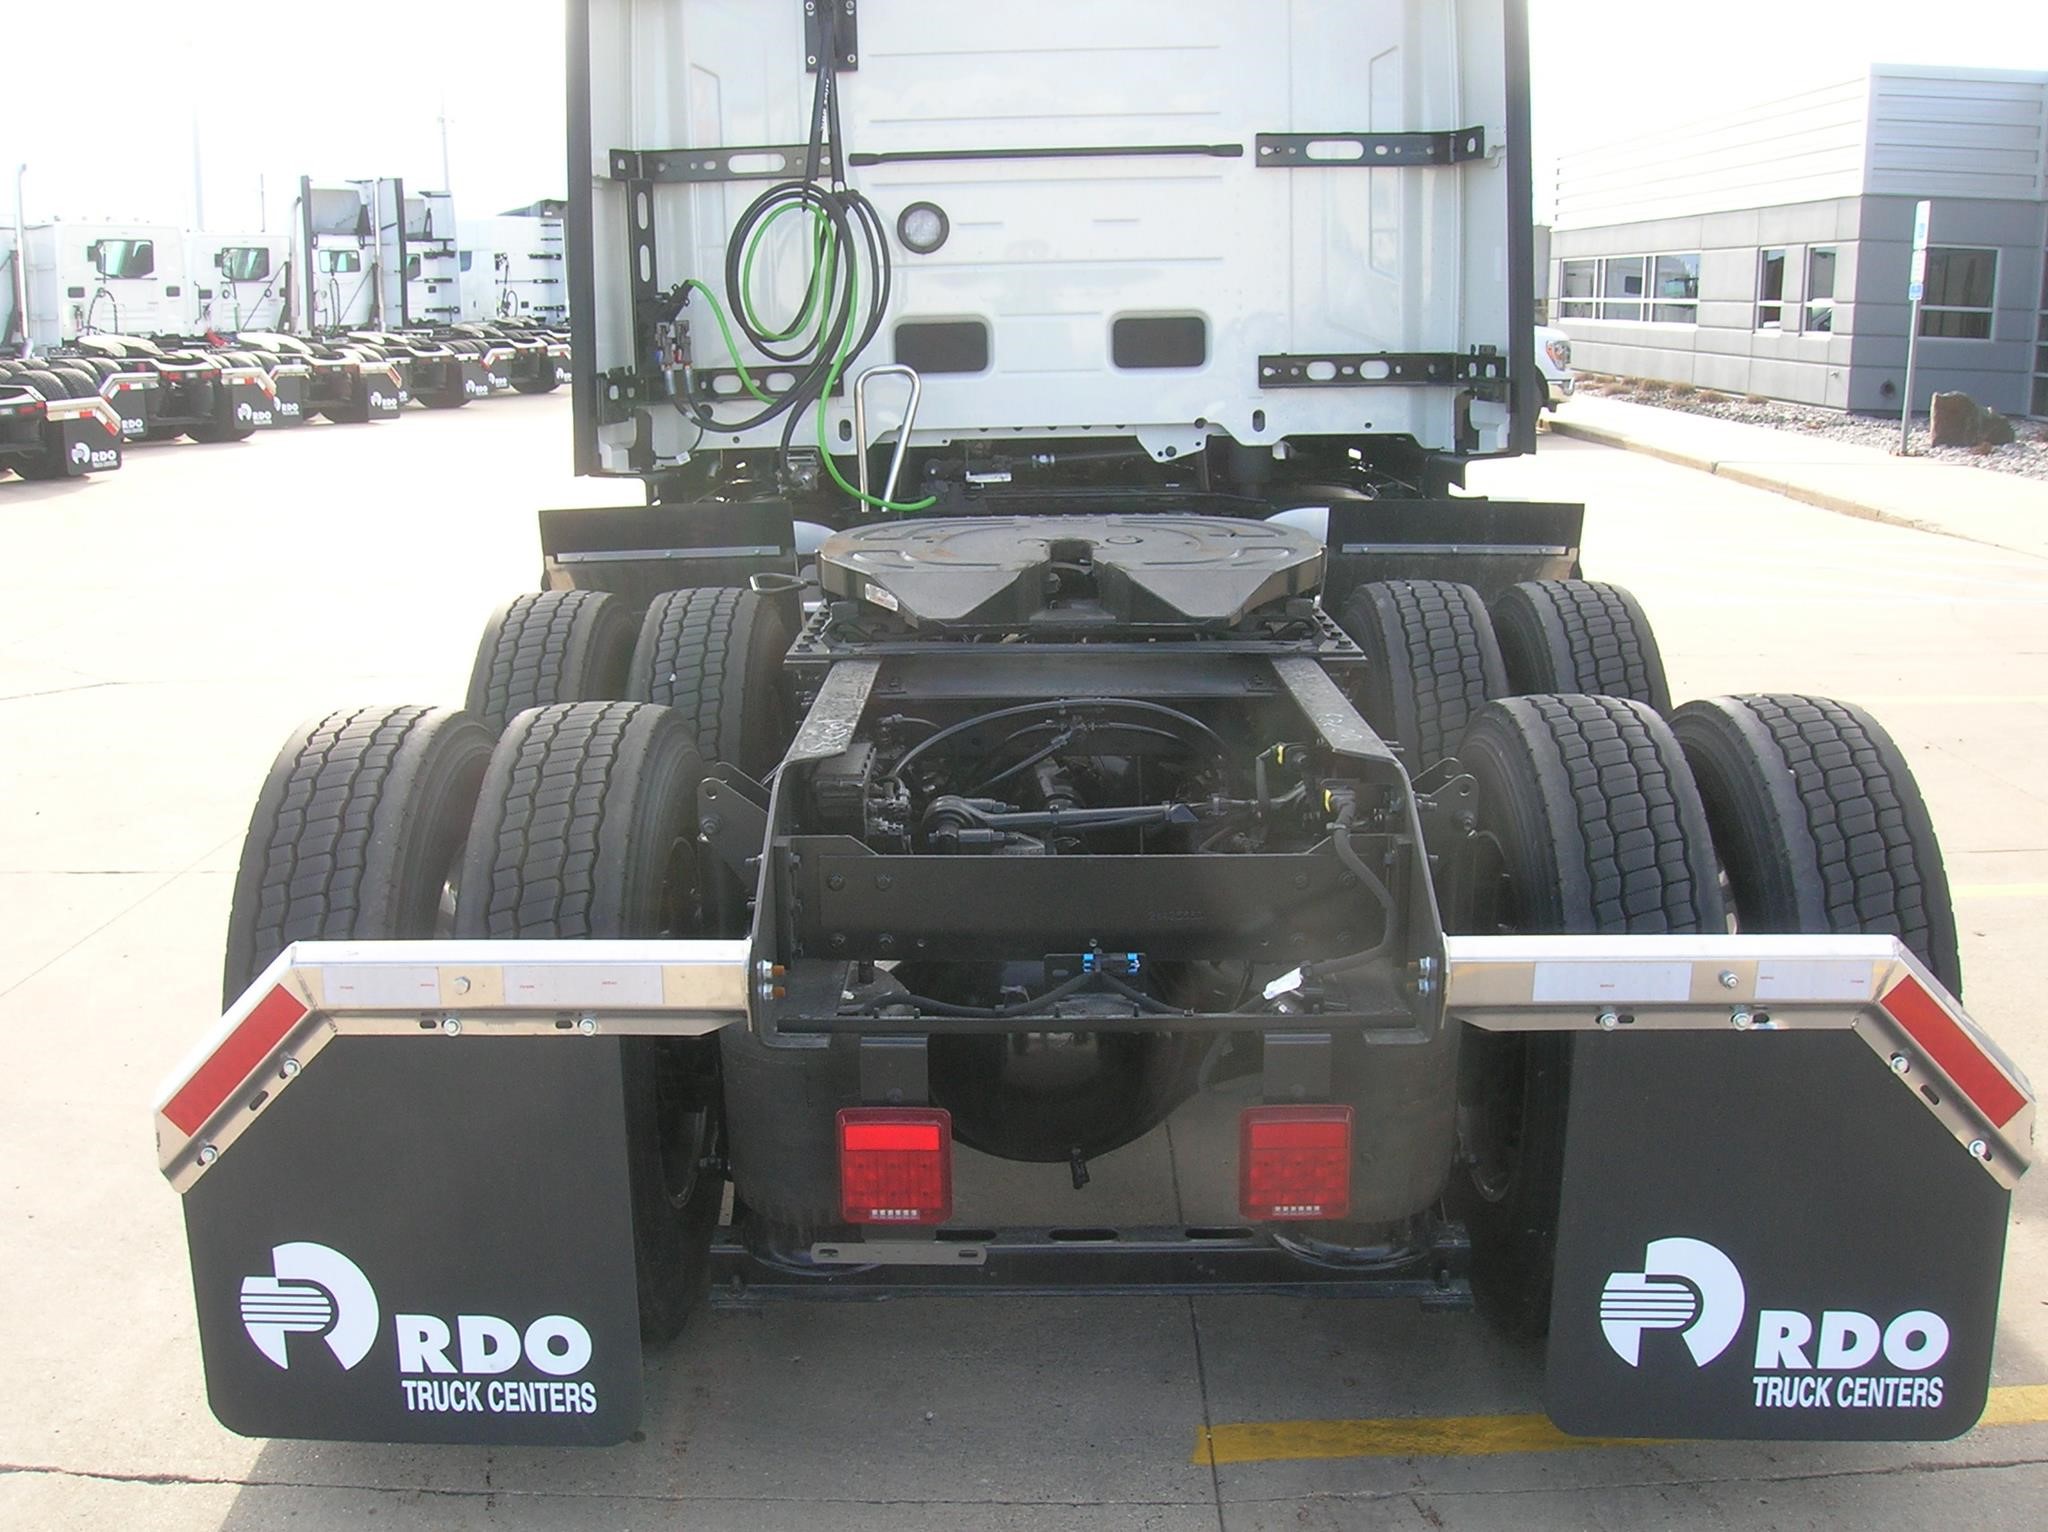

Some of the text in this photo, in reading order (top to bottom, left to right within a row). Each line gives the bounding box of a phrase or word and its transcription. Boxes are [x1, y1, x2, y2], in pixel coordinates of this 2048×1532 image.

[252, 411, 272, 420] RDO
[281, 403, 299, 411] RDO
[121, 419, 144, 428] RDO
[91, 450, 117, 462] RDO
[395, 1314, 592, 1375] RDO
[1754, 1310, 1949, 1371] RDO
[401, 1380, 597, 1414] TRUCK CENTERS
[1752, 1376, 1944, 1408] TRUCK CENTERS
